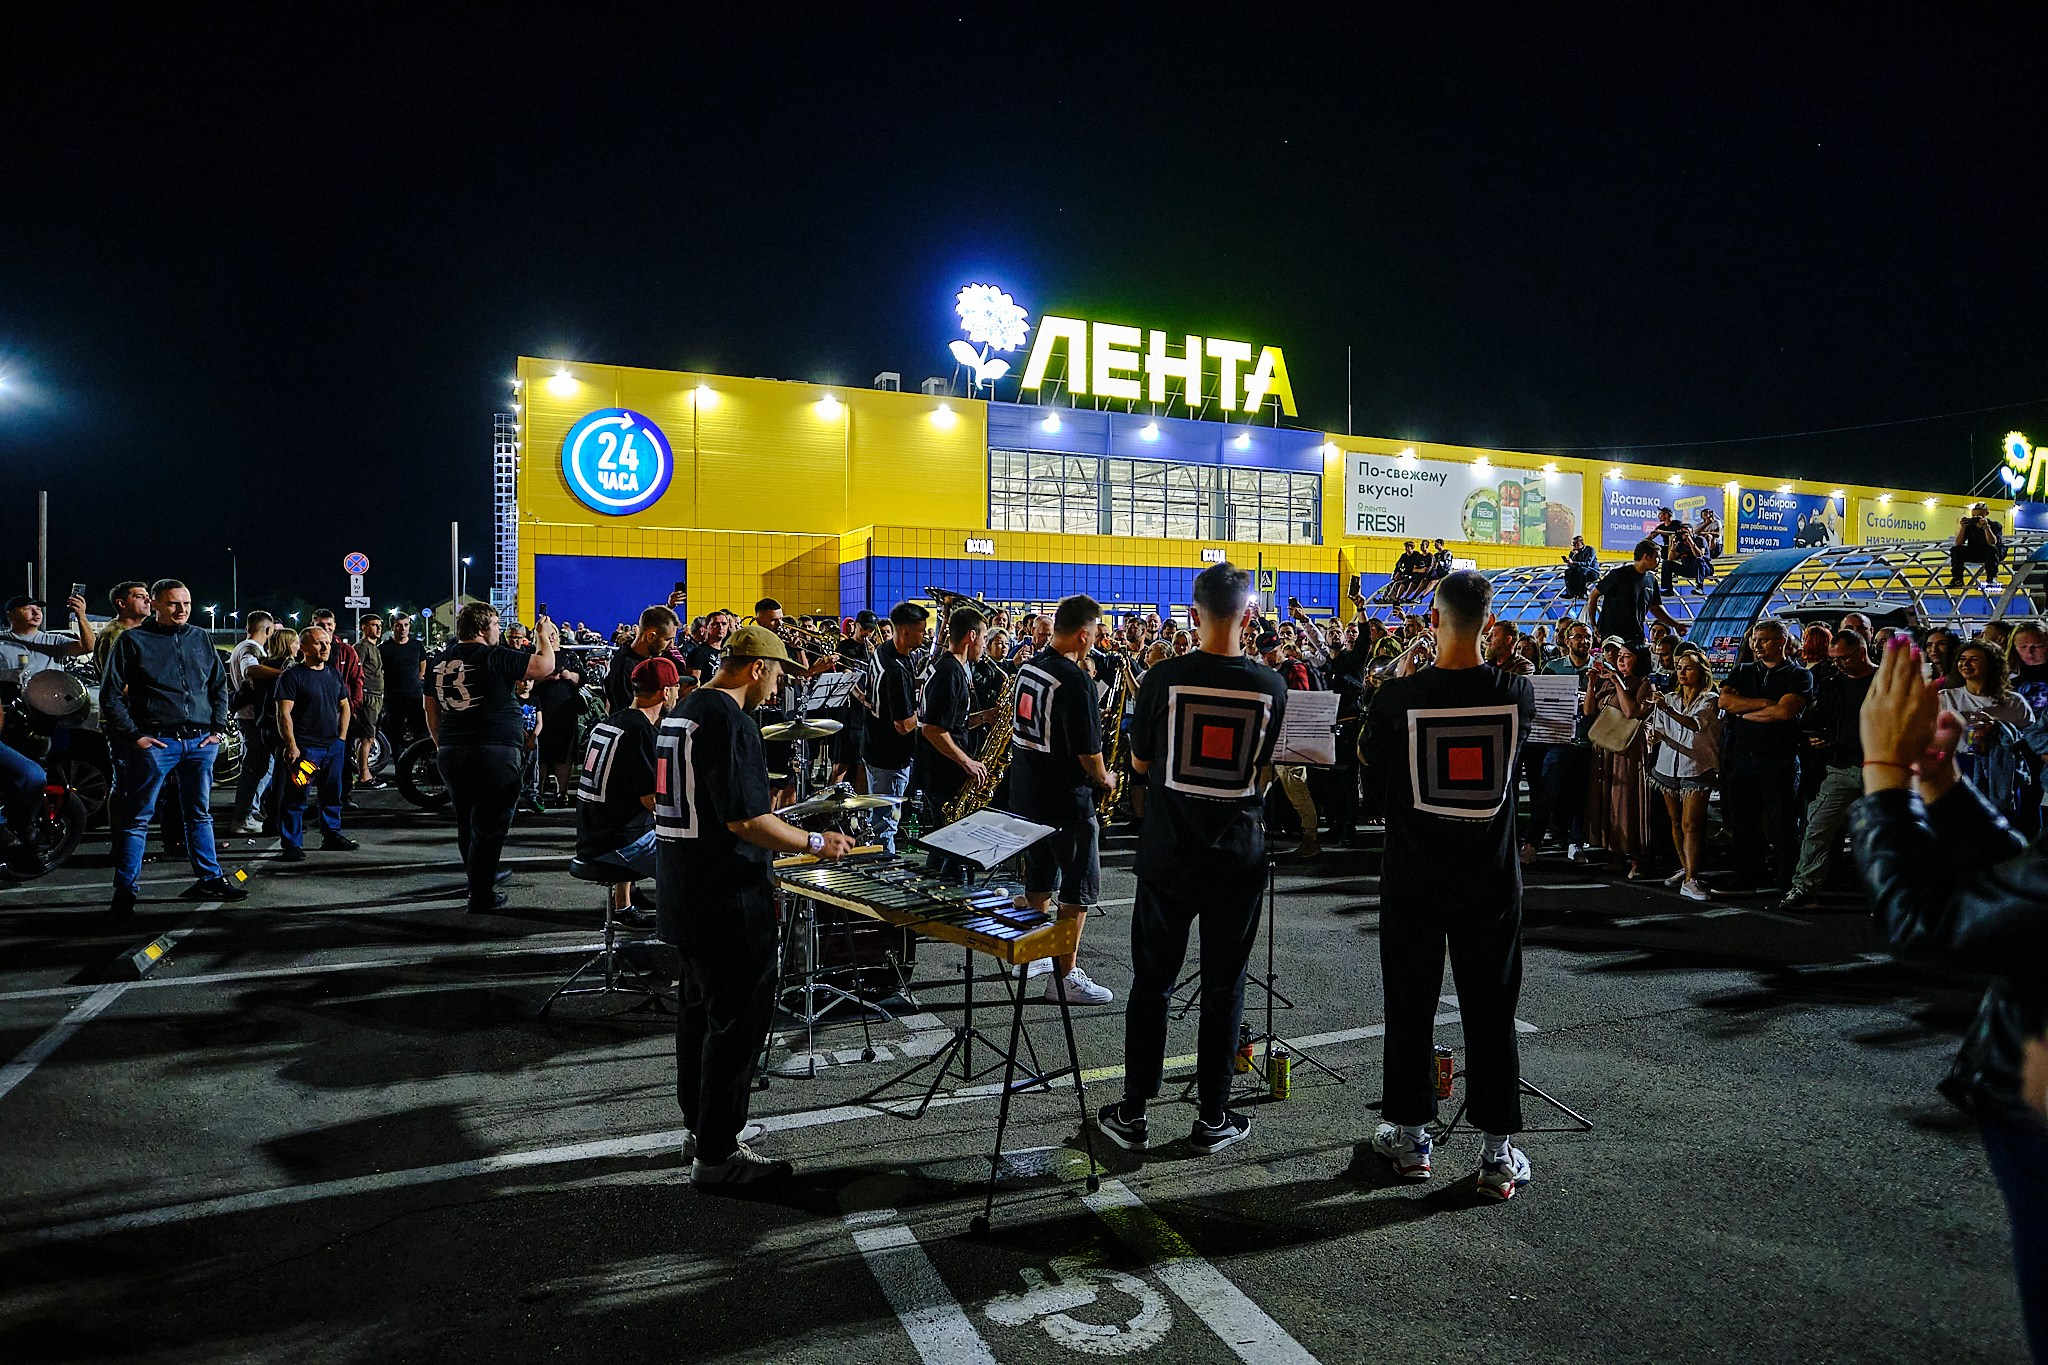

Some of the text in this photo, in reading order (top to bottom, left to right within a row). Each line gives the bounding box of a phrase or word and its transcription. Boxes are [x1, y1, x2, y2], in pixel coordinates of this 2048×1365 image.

[1020, 315, 1299, 418] ЛЕНТА
[598, 431, 640, 471] 24
[598, 470, 640, 492] ЧАСА
[1359, 461, 1448, 487] По-свежему
[1358, 483, 1413, 500] вкусно!
[1610, 490, 1660, 507] Доставка
[1364, 504, 1387, 513] лента
[1758, 494, 1797, 511] Выбираю
[1610, 507, 1618, 516] и
[1757, 507, 1784, 524] Ленту
[1357, 513, 1405, 533] FRESH
[1750, 522, 1768, 531] работы
[1866, 512, 1926, 531] Стабильно
[1745, 537, 1754, 545] 918
[1754, 537, 1764, 546] 649
[1765, 538, 1773, 546] 03
